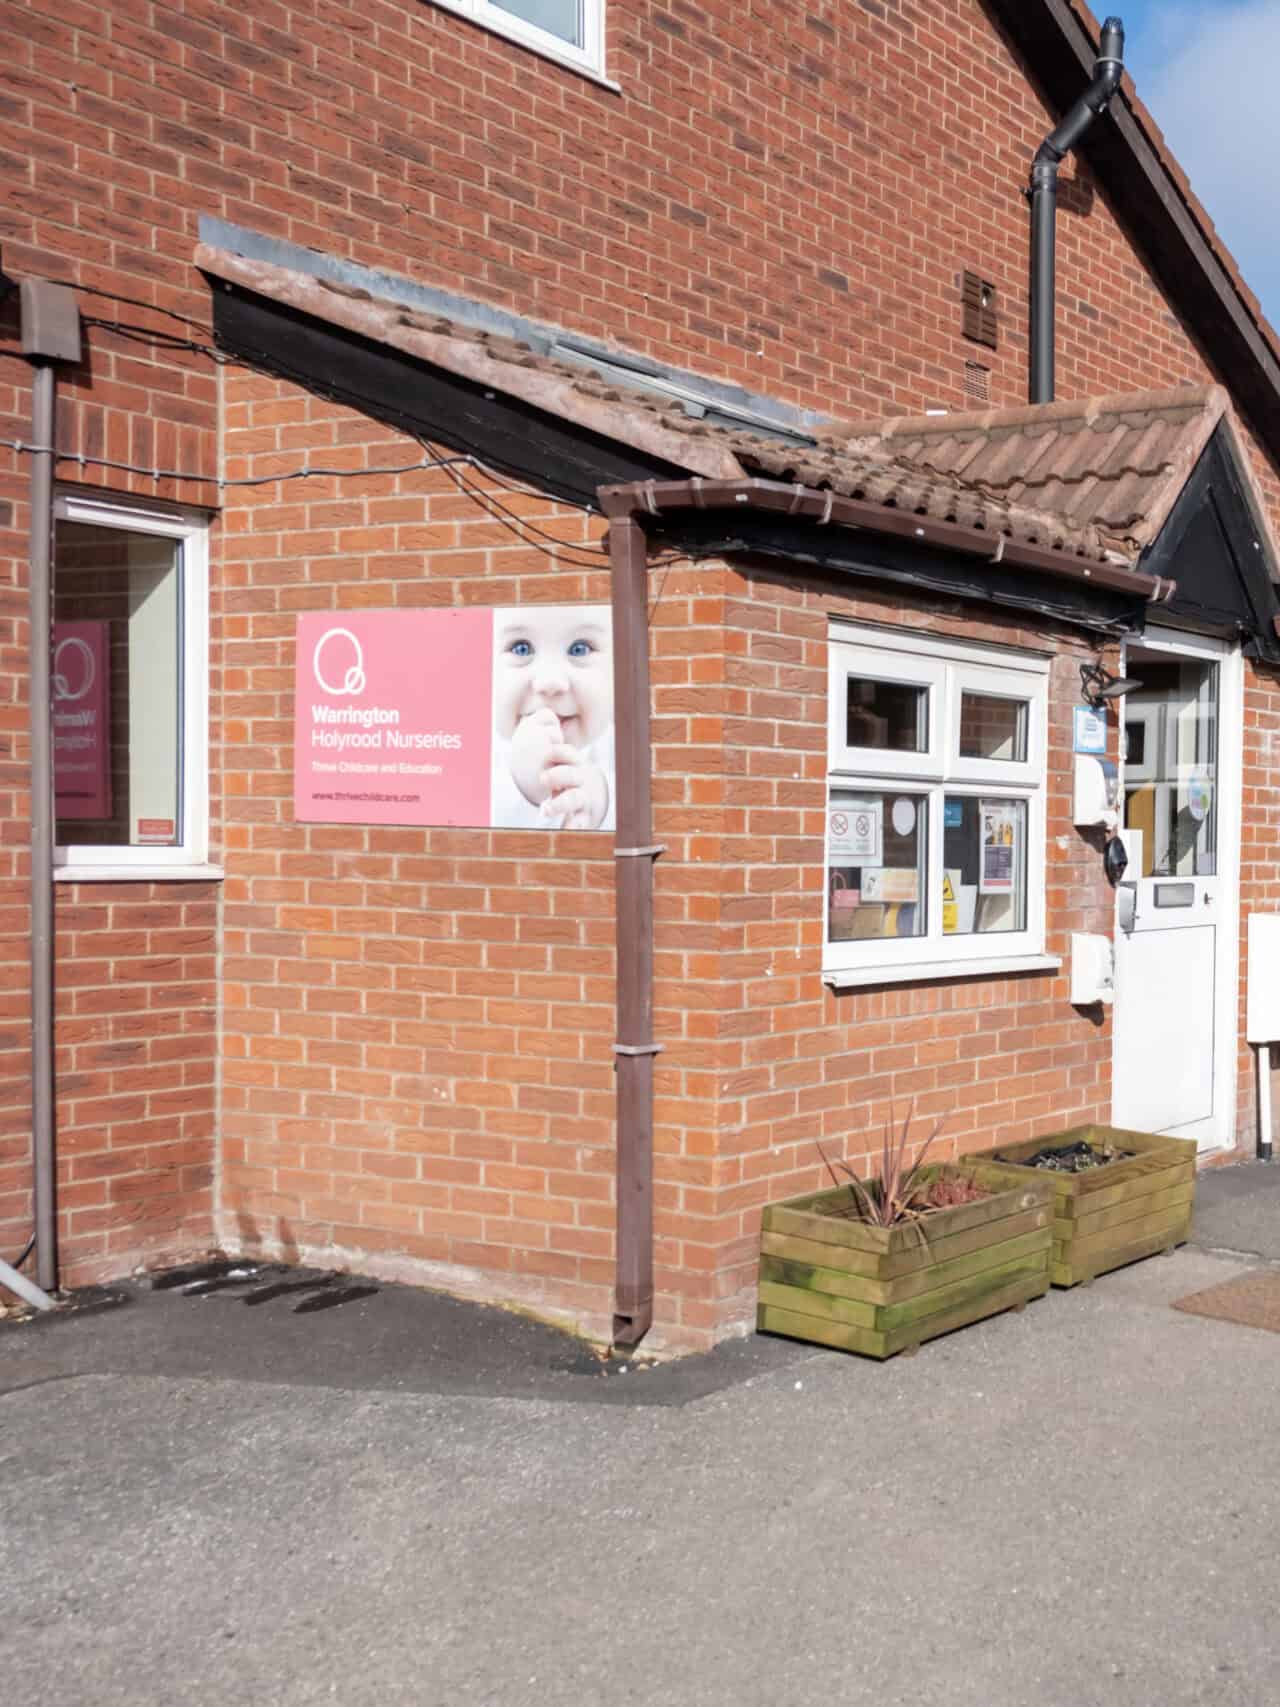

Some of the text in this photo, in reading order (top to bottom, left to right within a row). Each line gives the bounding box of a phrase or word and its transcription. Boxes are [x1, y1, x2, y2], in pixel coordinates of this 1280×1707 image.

[311, 704, 400, 728] Warrington
[311, 729, 462, 752] Holyrood Nurseries
[399, 762, 443, 776] Education
